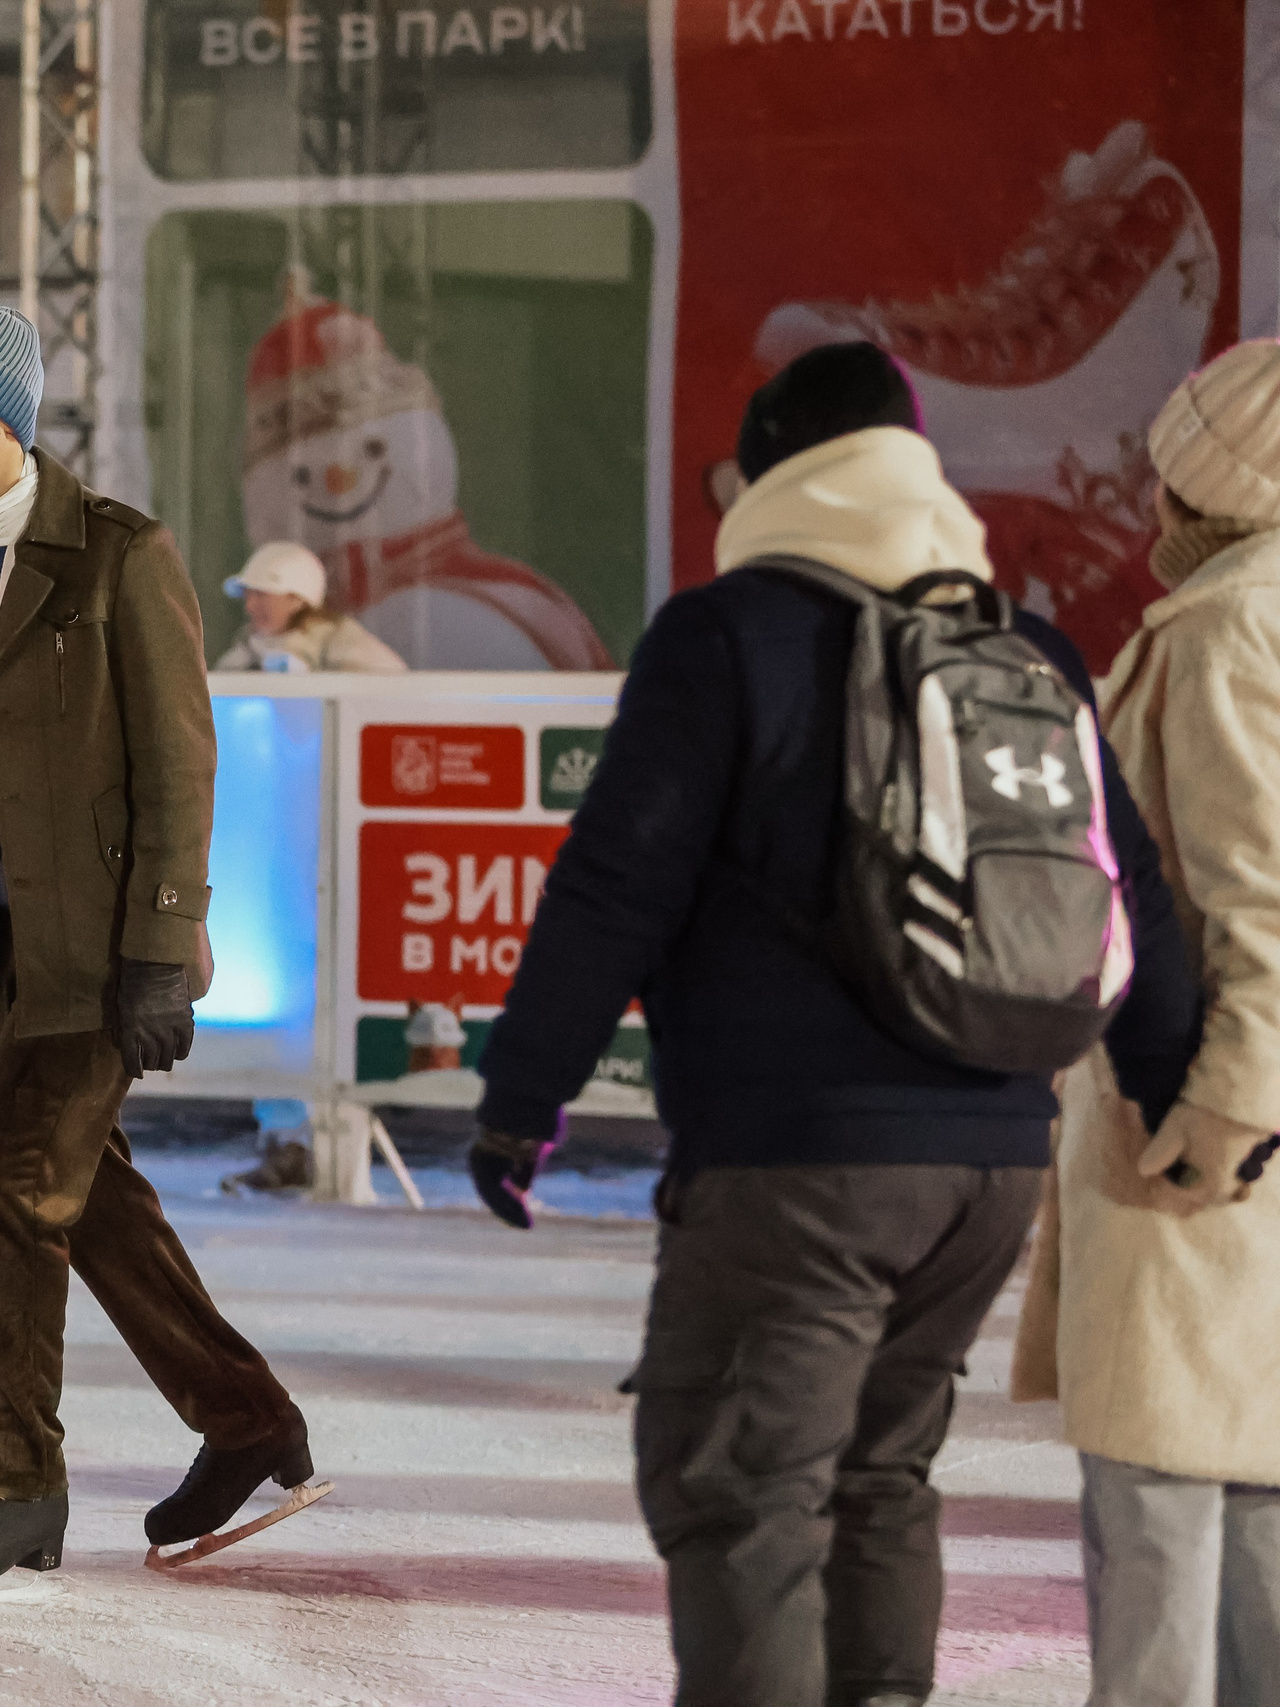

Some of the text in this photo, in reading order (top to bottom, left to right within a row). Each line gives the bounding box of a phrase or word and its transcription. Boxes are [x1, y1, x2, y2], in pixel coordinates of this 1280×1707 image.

[200, 5, 586, 66] ВСЕ В ПАРК!
[727, 0, 1084, 45] КАТАТЬСЯ!
[402, 931, 434, 974] В
